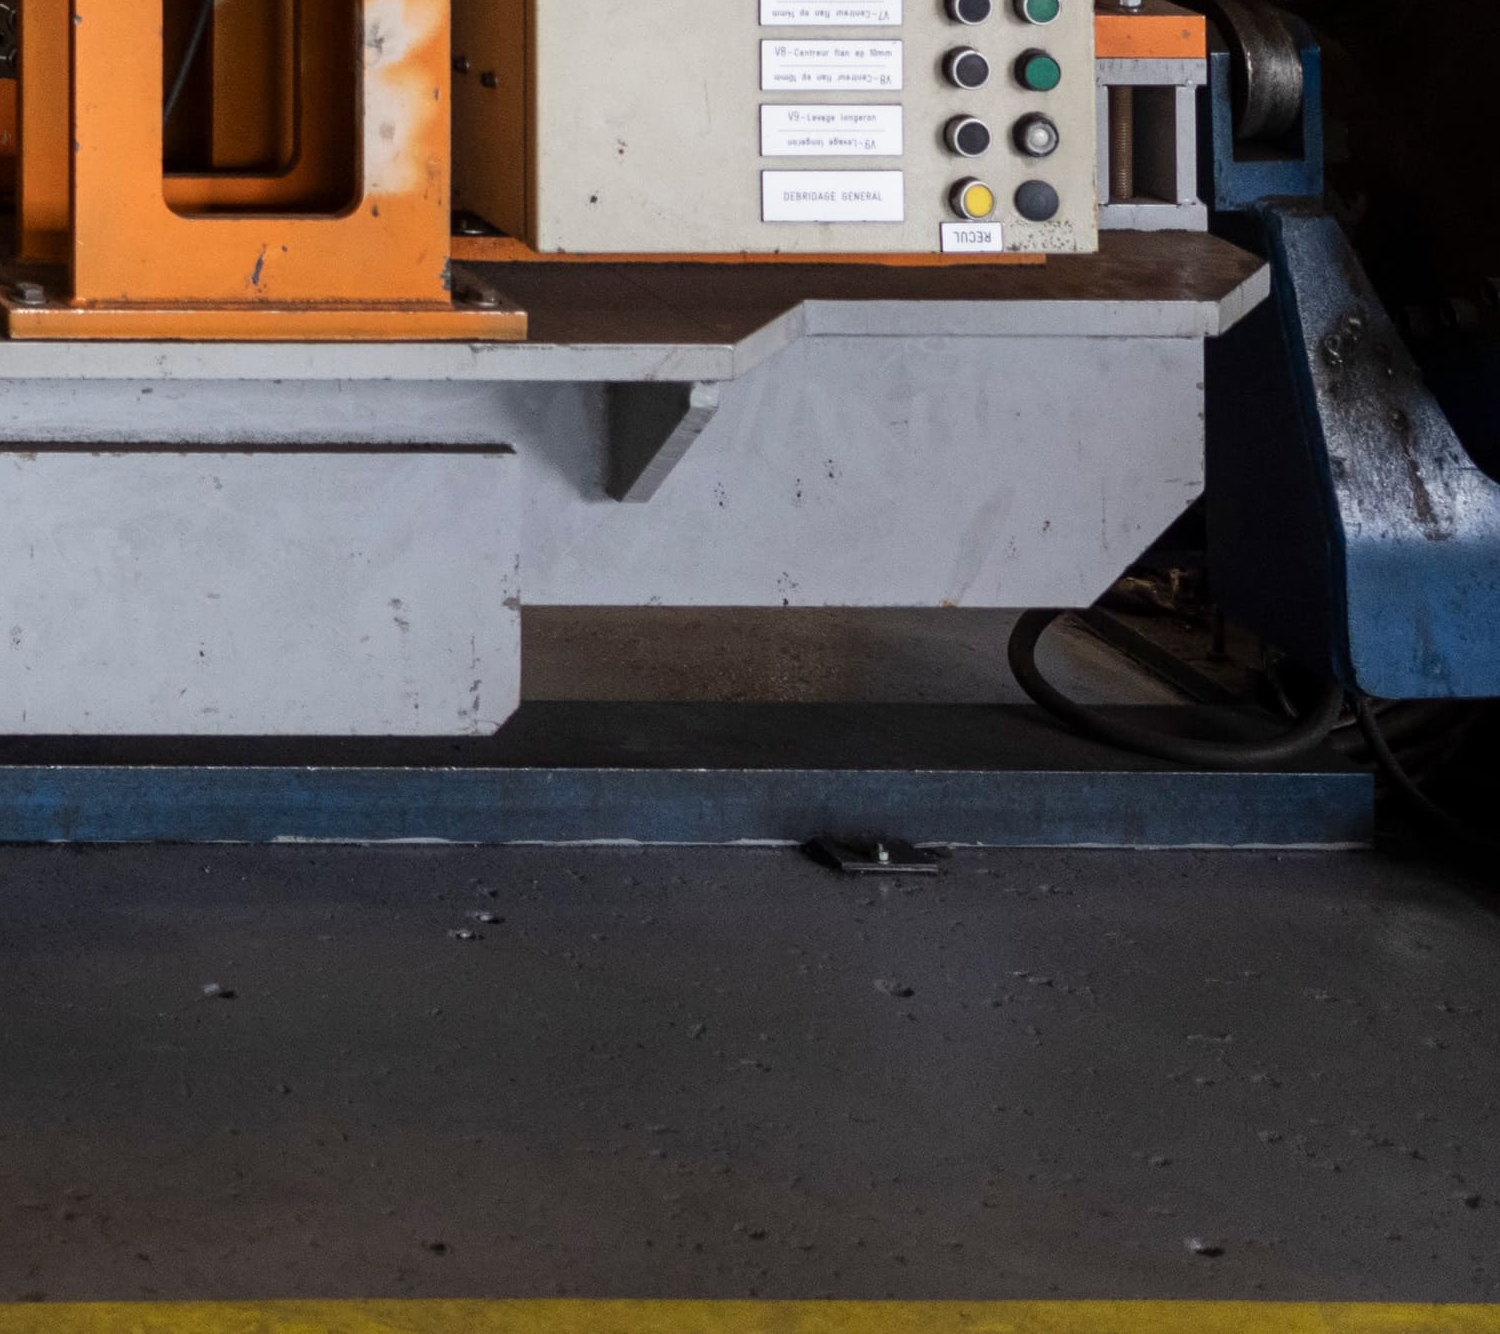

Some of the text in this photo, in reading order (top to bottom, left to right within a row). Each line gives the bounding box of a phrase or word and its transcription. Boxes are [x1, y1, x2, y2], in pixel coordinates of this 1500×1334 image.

[854, 50, 865, 58] ep
[840, 114, 876, 124] longeron
[783, 191, 882, 201] DEBRIDAGE GENERAL
[953, 230, 992, 244] RECUL
